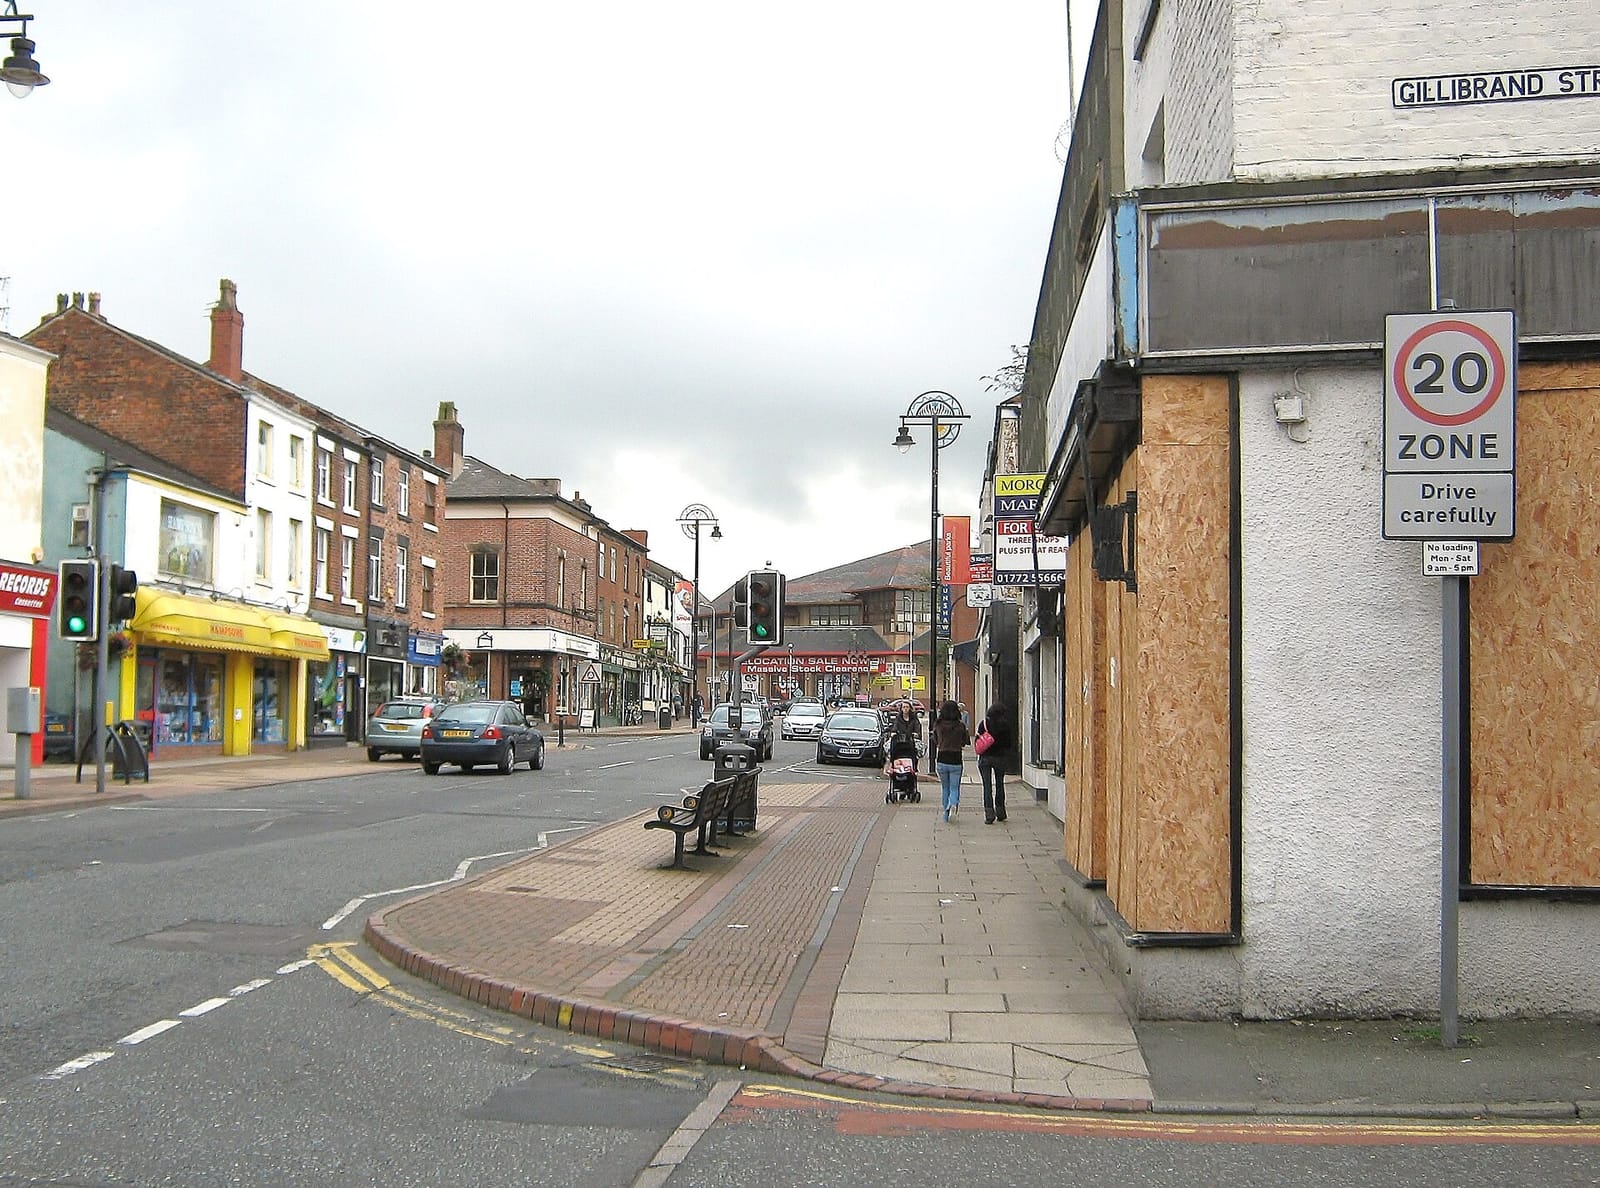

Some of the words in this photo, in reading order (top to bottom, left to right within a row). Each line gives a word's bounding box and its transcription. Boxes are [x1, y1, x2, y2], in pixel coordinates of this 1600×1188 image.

[1400, 73, 1543, 103] GILLIBRAND
[1412, 352, 1488, 394] 20
[1398, 433, 1498, 459] ZONE
[1421, 483, 1476, 499] Drive
[1400, 506, 1497, 526] carefully
[1003, 522, 1028, 534] FOR
[1442, 544, 1474, 552] loading
[1455, 554, 1471, 562] Sat
[0, 573, 50, 596] RECORDS
[997, 574, 1028, 583] 01772
[741, 657, 804, 665] LOCATION
[808, 657, 838, 665] SALE
[841, 657, 869, 665] NOW
